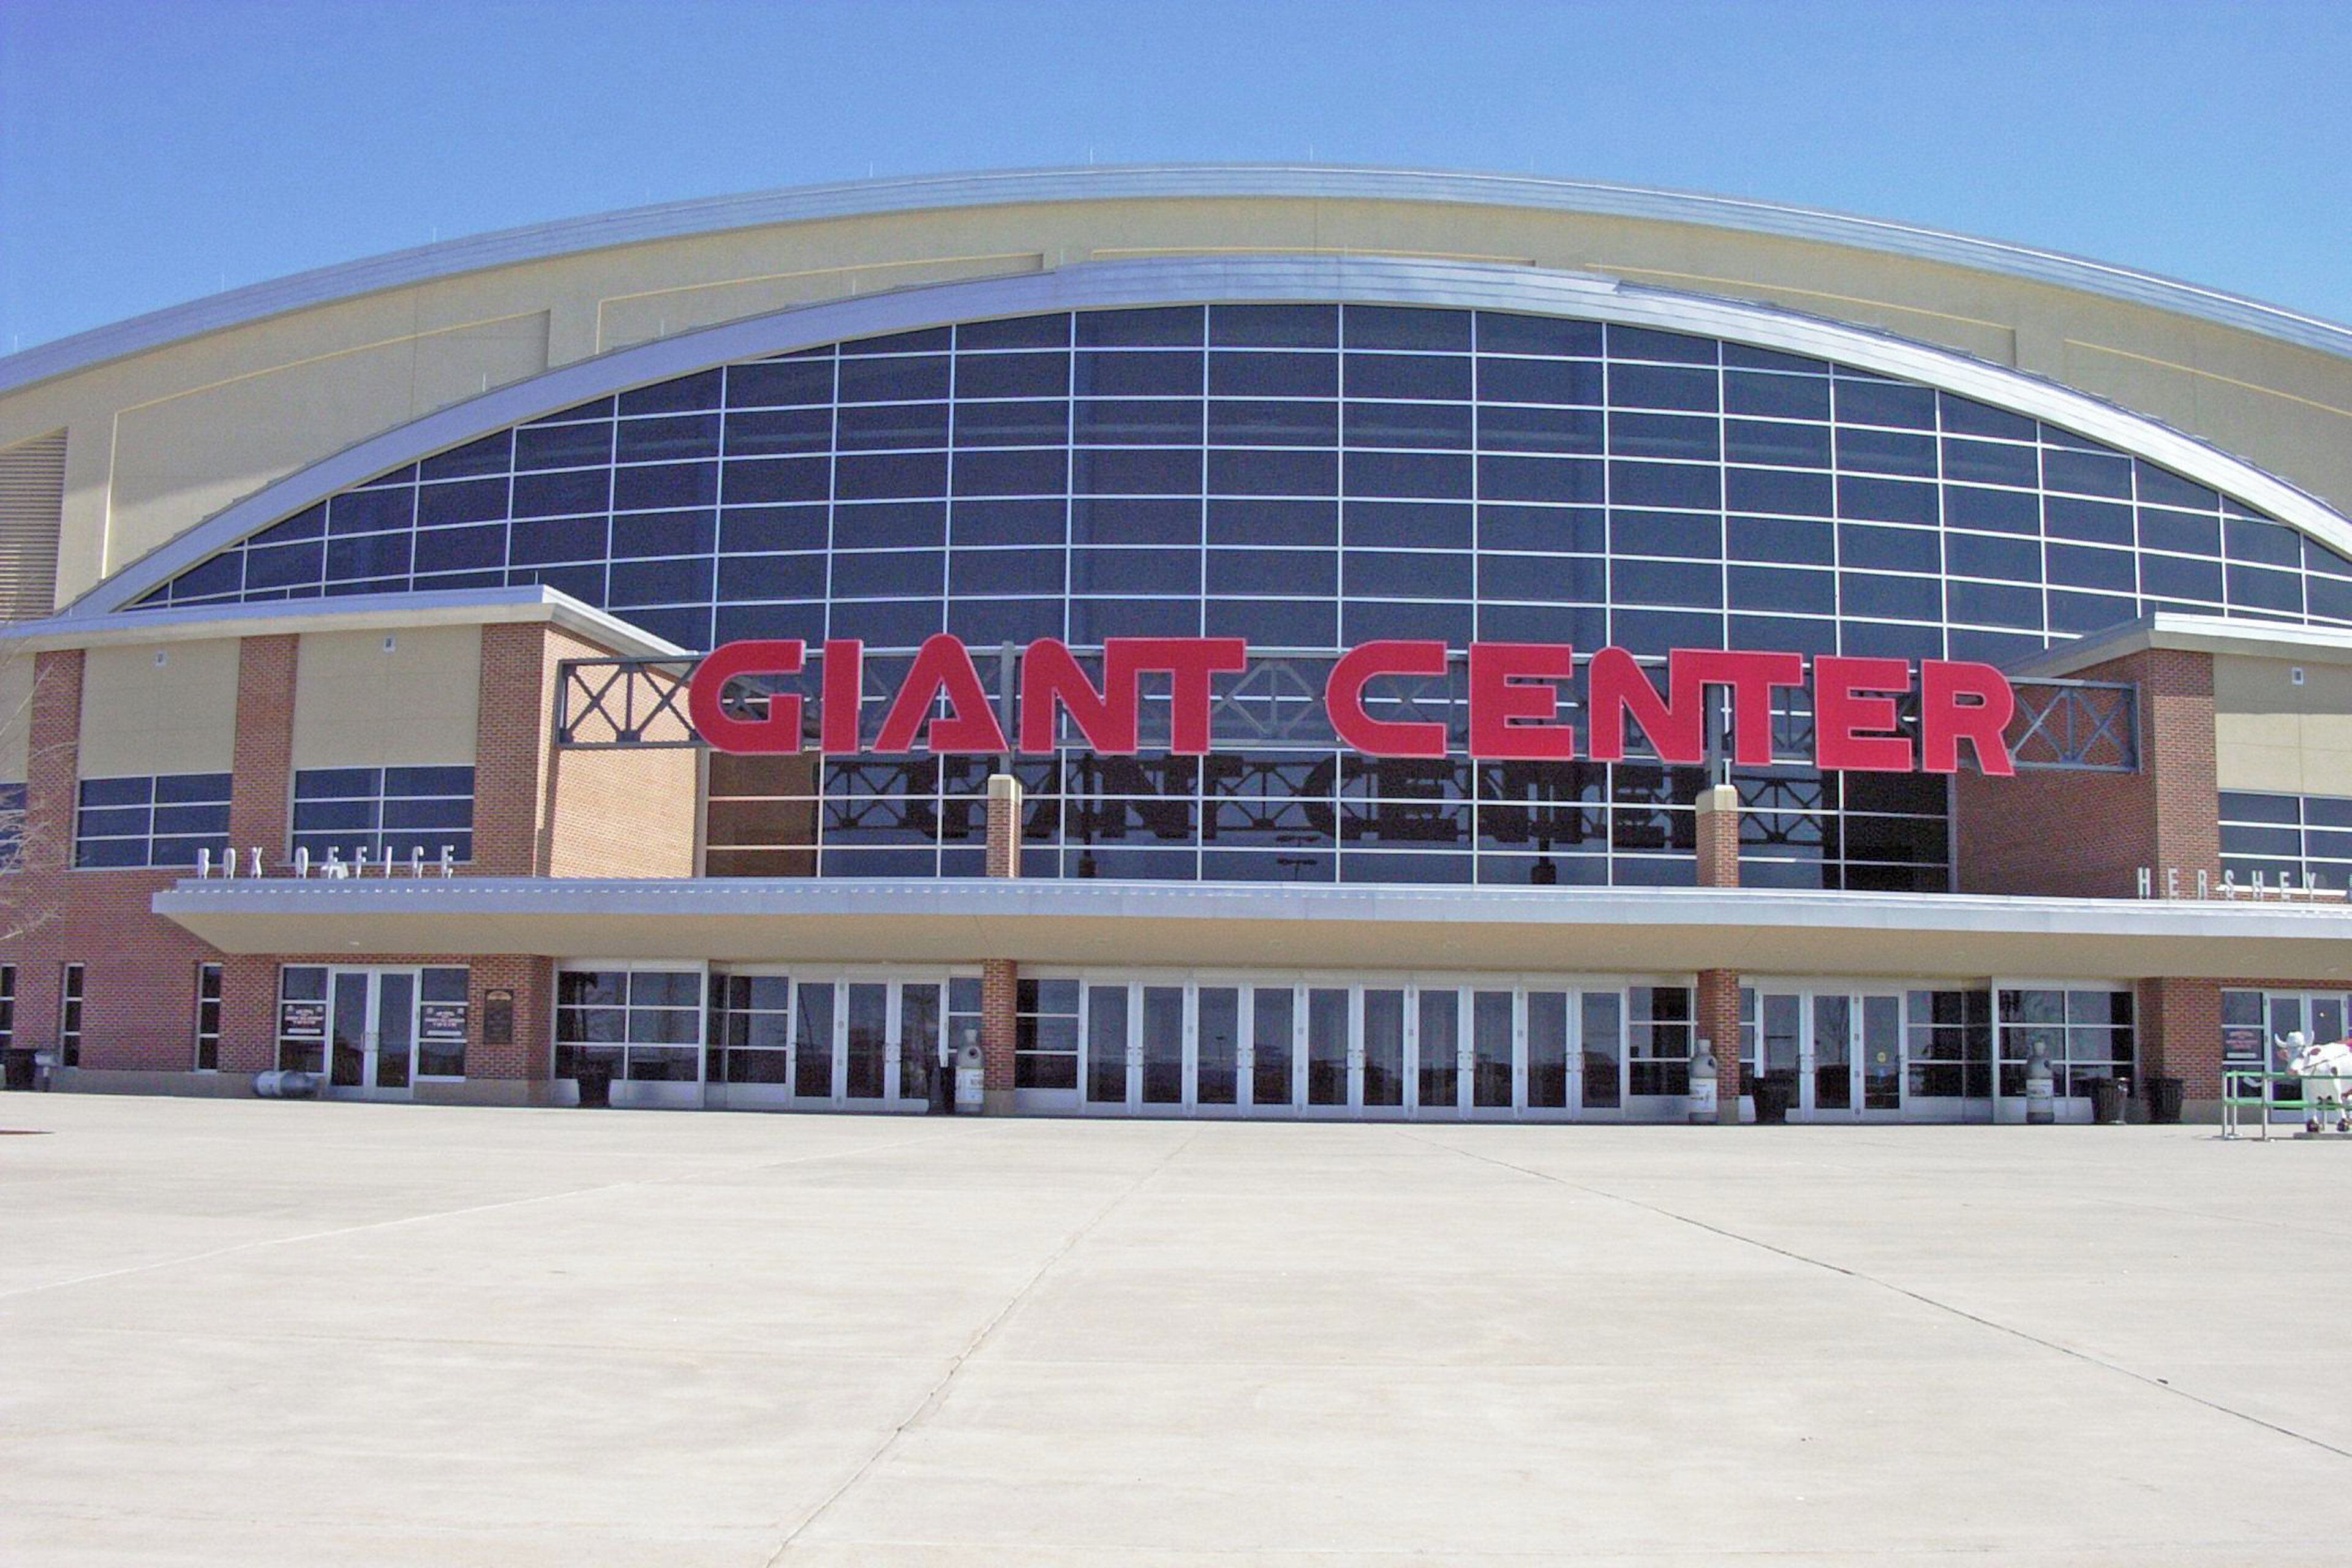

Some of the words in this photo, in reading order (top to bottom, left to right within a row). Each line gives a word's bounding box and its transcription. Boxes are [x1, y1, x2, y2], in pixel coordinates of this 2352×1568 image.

[688, 633, 1246, 756] GIANT
[1325, 639, 2015, 777] CENTER
[197, 846, 263, 880] BOX
[295, 845, 454, 880] OFFICE
[2136, 866, 2318, 902] HERSHEY
